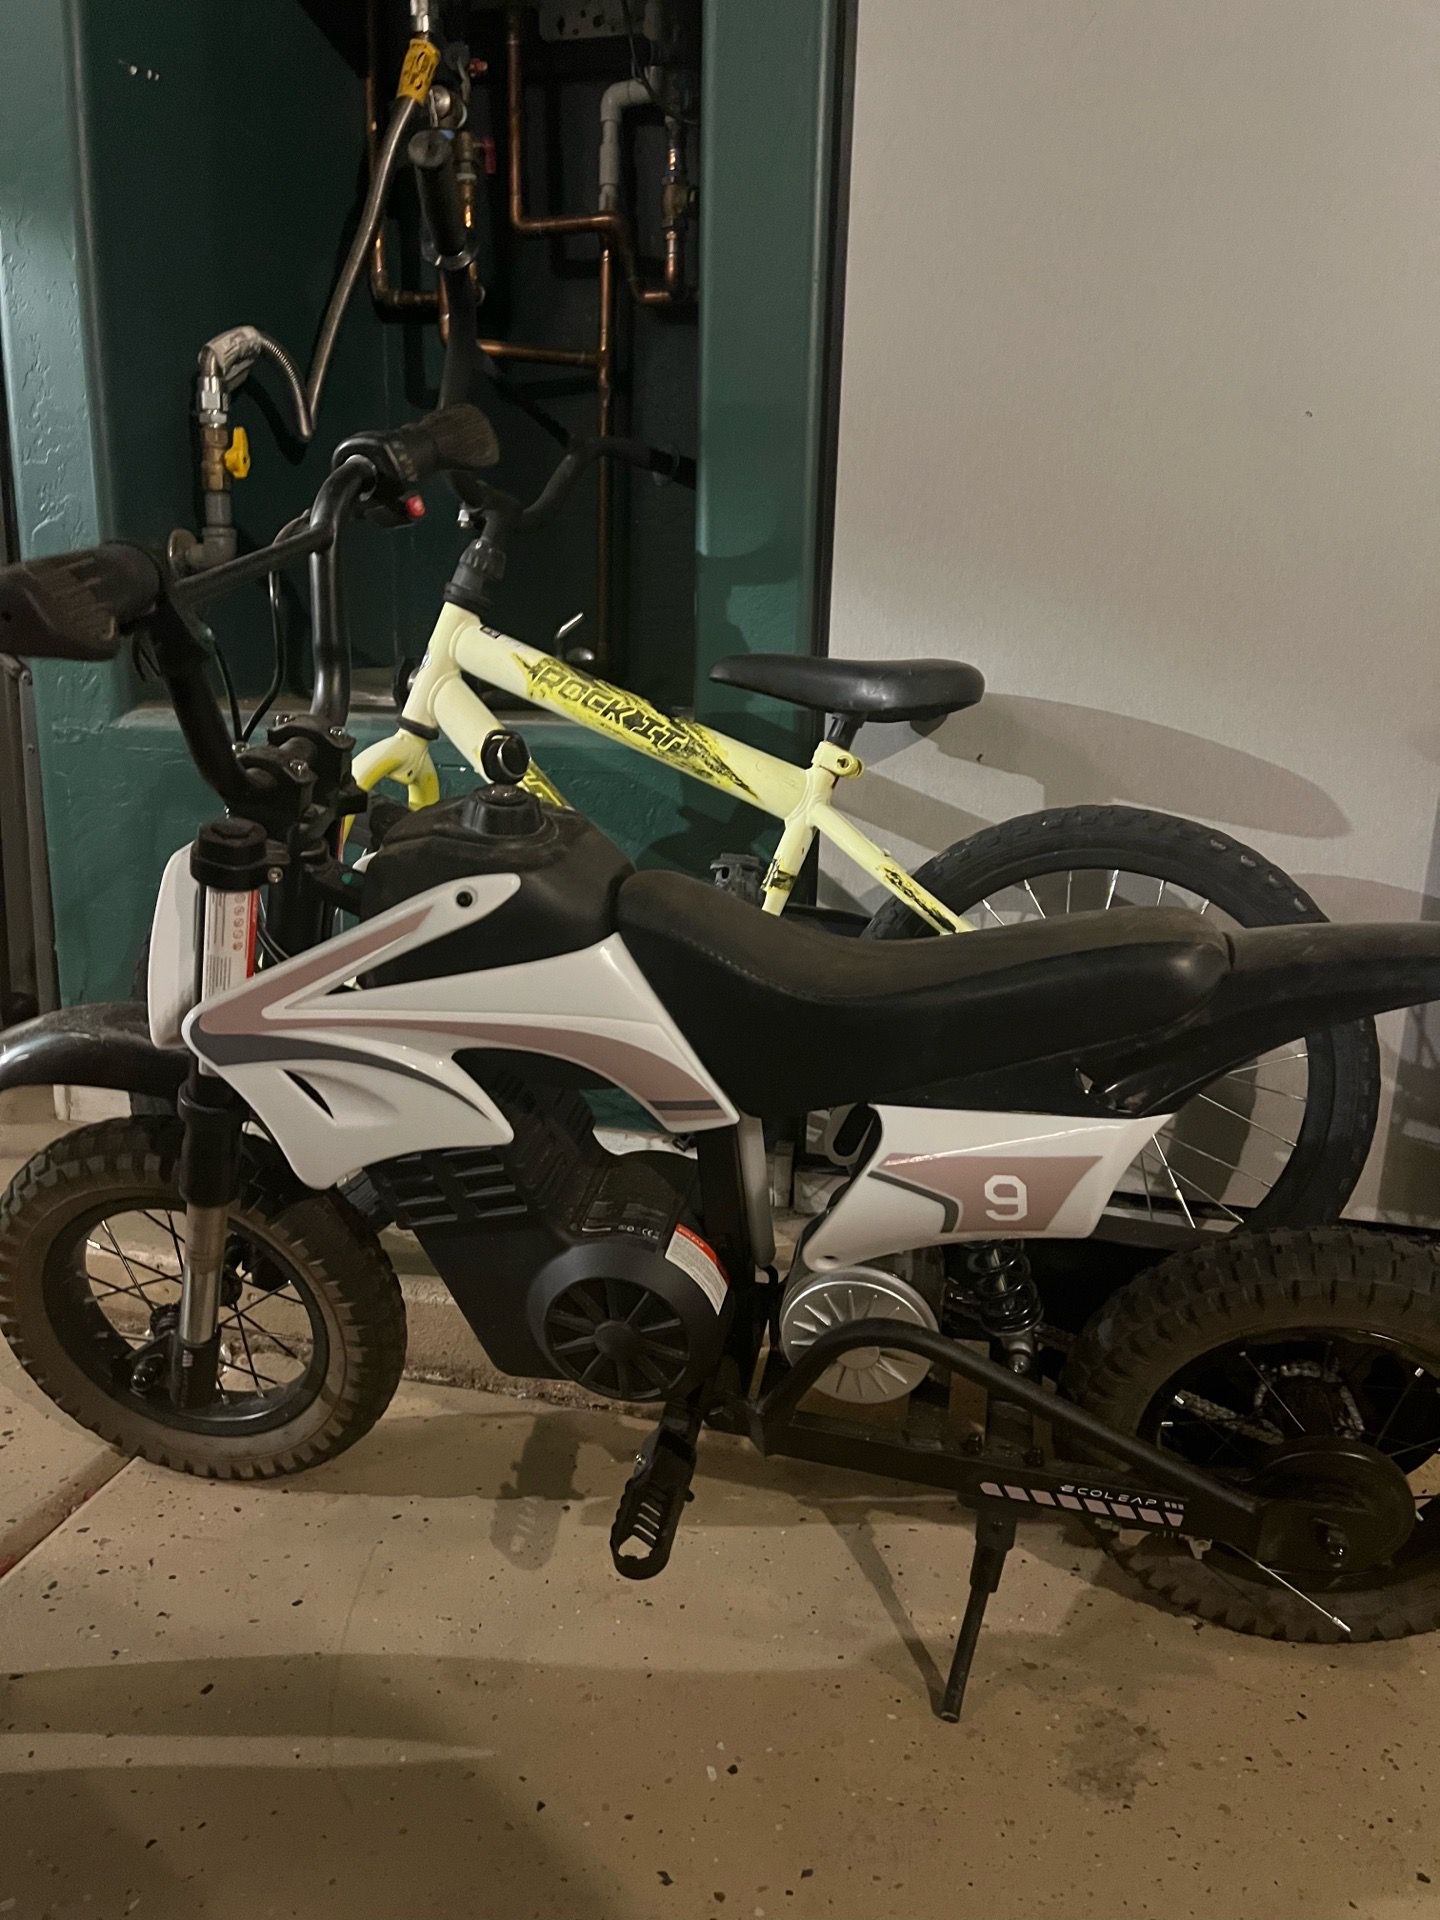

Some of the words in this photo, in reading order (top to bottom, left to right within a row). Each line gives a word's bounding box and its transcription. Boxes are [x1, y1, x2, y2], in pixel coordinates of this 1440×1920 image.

[533, 664, 638, 727] ROCK
[630, 714, 690, 752] IT
[984, 1174, 1028, 1221] 9
[1060, 1484, 1157, 1506] ECOLEAP
